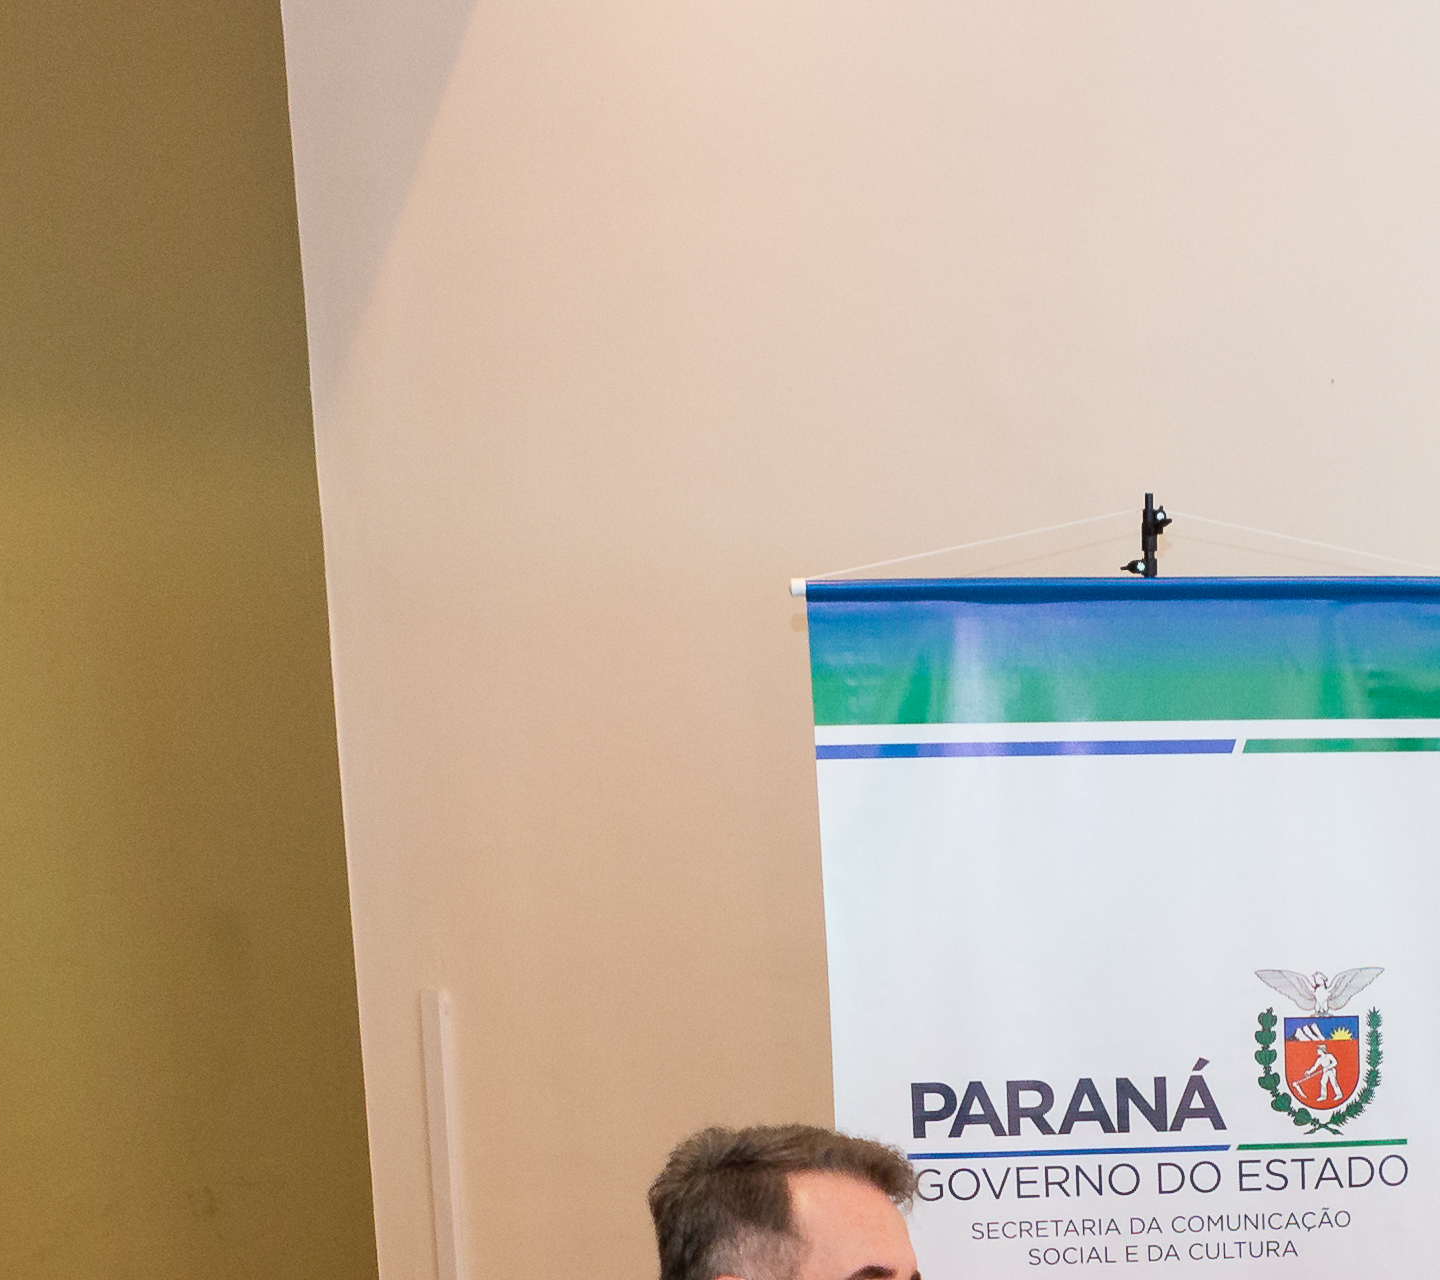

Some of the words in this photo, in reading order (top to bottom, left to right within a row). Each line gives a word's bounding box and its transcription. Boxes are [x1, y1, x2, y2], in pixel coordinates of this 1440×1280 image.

[910, 1057, 1227, 1139] PARANÁ
[917, 1163, 1140, 1202] GOVERNO
[1158, 1160, 1222, 1194] DO
[1238, 1154, 1409, 1192] ESTADO
[971, 1217, 1121, 1240] SECRETARIA
[1130, 1216, 1163, 1235] DA
[1171, 1207, 1352, 1233] COMUNICAÇÃO
[1028, 1246, 1117, 1266] SOCIAL
[1125, 1245, 1139, 1263] E
[1147, 1243, 1181, 1262] DA
[1188, 1240, 1299, 1260] CULTURA
